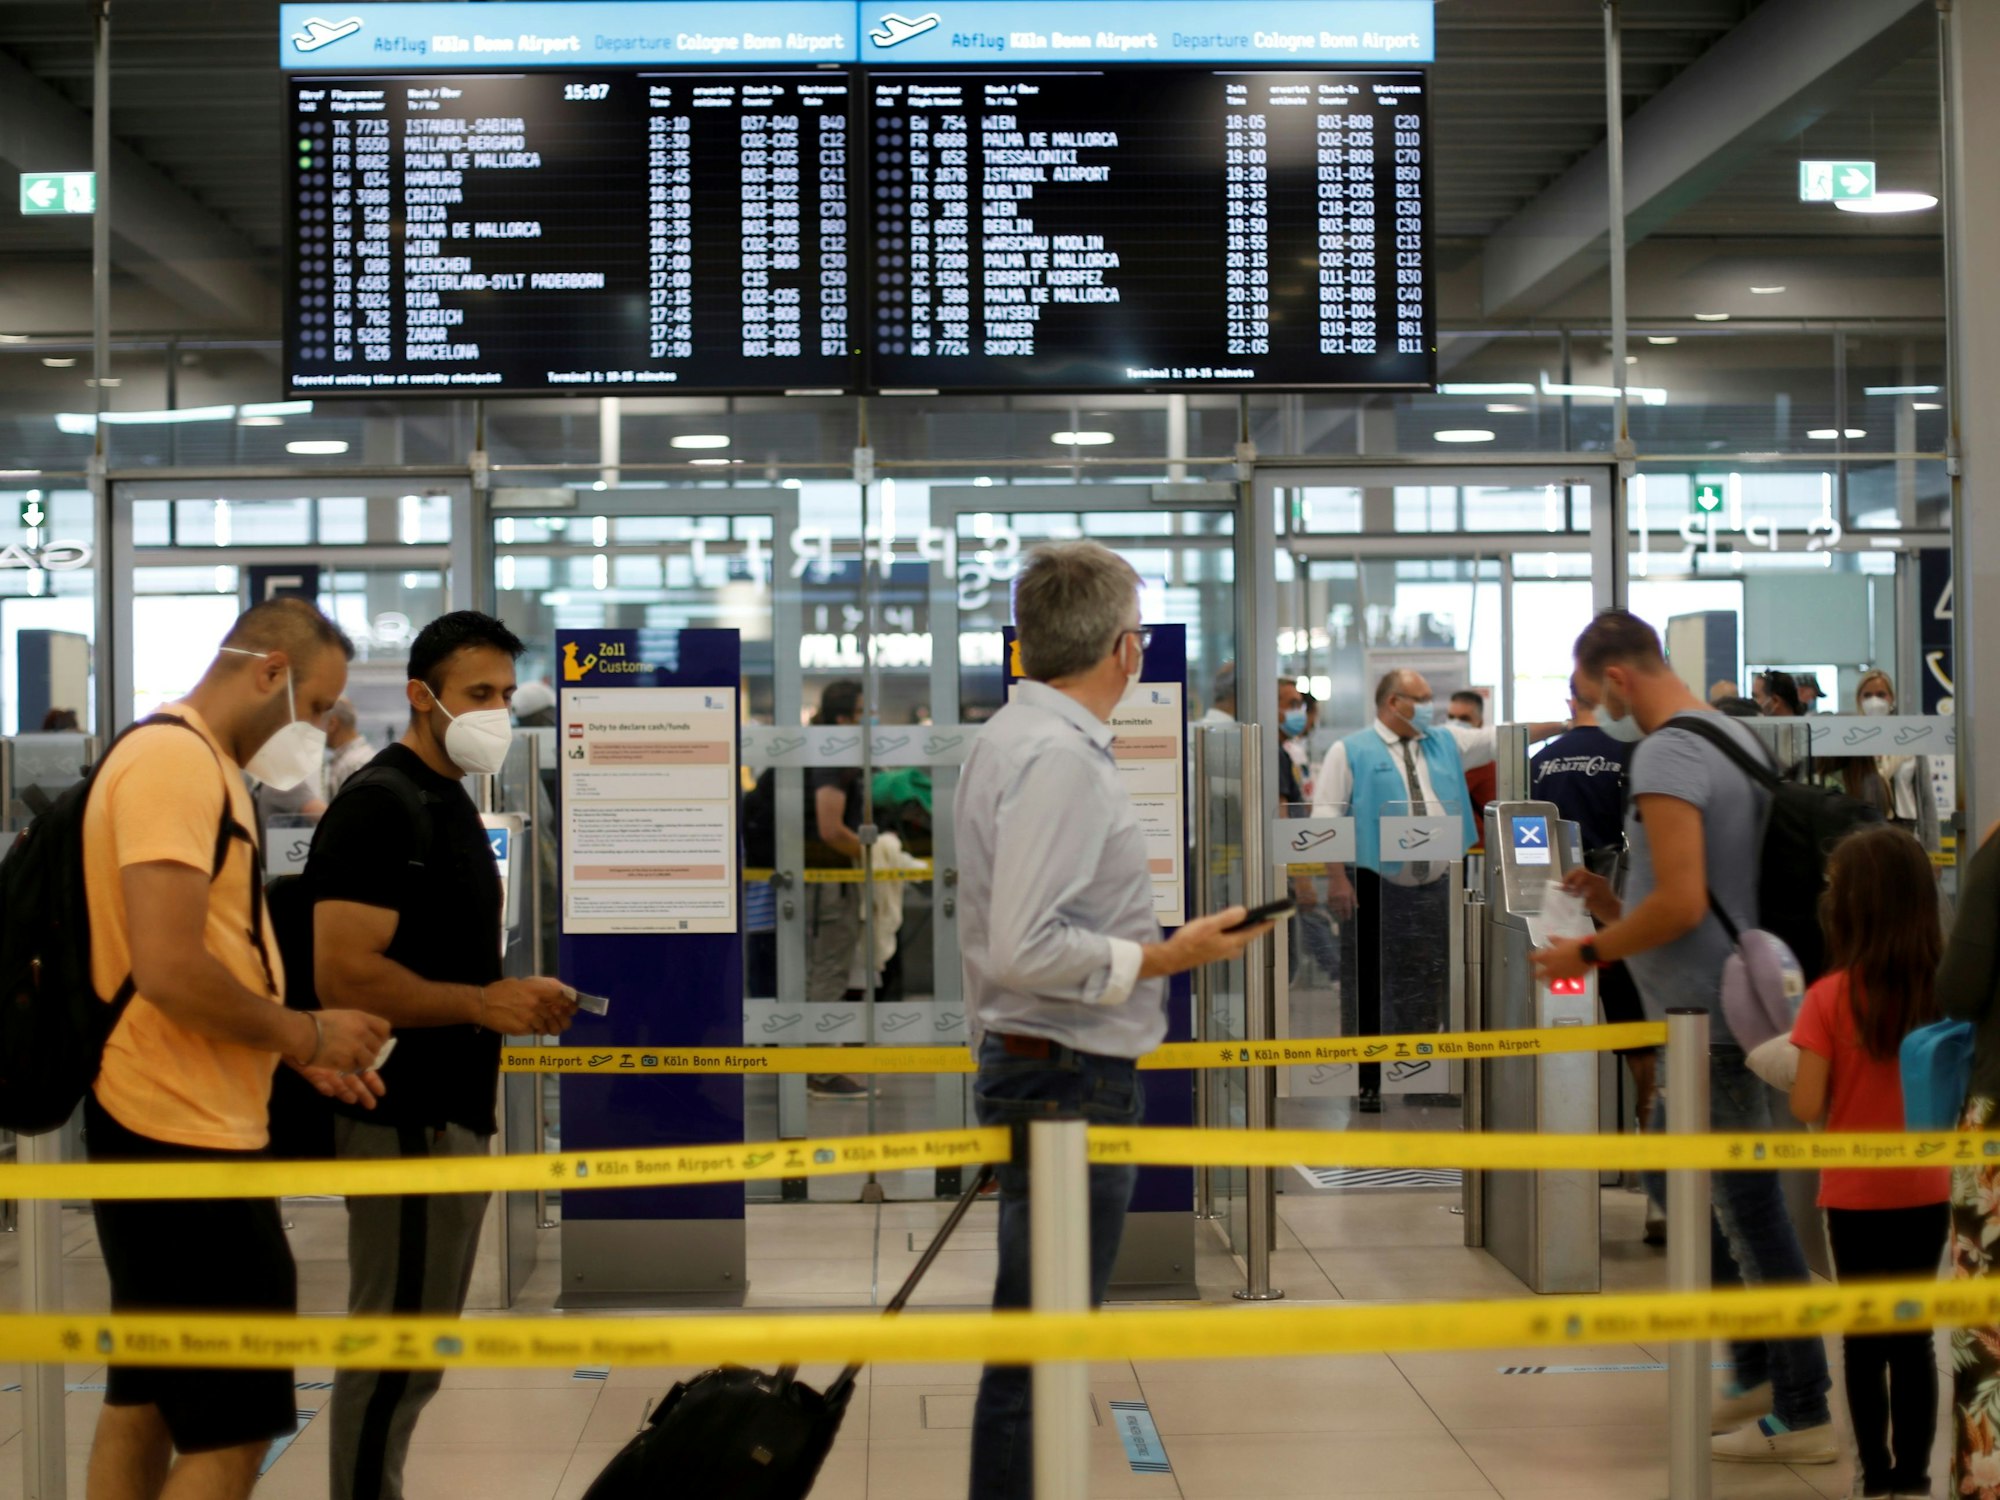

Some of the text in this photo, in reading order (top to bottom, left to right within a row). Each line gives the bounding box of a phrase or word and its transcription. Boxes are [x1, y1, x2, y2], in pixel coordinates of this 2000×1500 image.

[374, 37, 426, 53] Abflug
[473, 35, 513, 52] Bonn
[518, 35, 581, 54] Airport
[595, 35, 671, 50] Departure
[676, 33, 738, 50] Cologne
[743, 34, 782, 50] Bonn
[786, 33, 844, 50] Airport
[952, 33, 1004, 50] Abflug
[1052, 33, 1092, 48] Bonn
[1095, 32, 1157, 49] Airport
[1172, 33, 1249, 49] Departure
[1253, 32, 1315, 48] Cologne
[1320, 32, 1359, 48] Bonn
[1363, 32, 1419, 49] Airport
[564, 83, 609, 100] 15:07
[649, 116, 690, 134] 15:10
[942, 114, 1419, 130] 754 WIEN 18:05 B03-B08 C20
[649, 133, 690, 149] 15:30
[910, 132, 1420, 147] FR PALMA DE MALLORCA 18:30 C02-C05 D10
[649, 151, 690, 166] 15:35
[941, 149, 1420, 165] 652 THESSALONIKI 19:00 B03-B08 C70
[405, 171, 462, 186] HAMBURG
[911, 166, 1420, 182] TK 1676 ISTANBUL AIRPORT 19:20 D31-D34 B50
[405, 188, 462, 204] CRAIOVA
[911, 183, 1420, 200] FR 8036 DUBLIN 19:35 C02-C05 B21
[407, 203, 690, 221] IBIZA 16:30
[910, 200, 1421, 217] OS WIEN 19:45 C18-C20 C50
[934, 218, 1421, 234] 8055 BERLIN 19:50 B03-B08 C30
[911, 235, 1421, 251] FR 1404 WARSCHAU MODLIN 19:55 C02-C05 C13
[911, 252, 1421, 269] FR 7208 PALMA DE MALLORCA 20:15 C02-C05 C12
[911, 271, 929, 286] XC
[936, 271, 968, 286] 1504
[1227, 270, 1268, 284] 20:20
[1320, 269, 1375, 284] D11-D12
[1397, 269, 1422, 284] B30
[406, 290, 440, 308] RIGA
[984, 288, 1026, 303] PALMA
[1031, 288, 1049, 303] DE
[1054, 287, 1120, 303] MALLORCA
[1227, 287, 1268, 302] 20:30
[1320, 287, 1376, 301] B03-B08
[1397, 287, 1422, 301] C40
[406, 307, 463, 325] ZUERICH
[912, 304, 1422, 321] PC 1608 KAYSERI 21:10 D01-D04 B40
[985, 321, 1422, 338] TANGER 21:30 B19-B22 B61
[406, 341, 691, 360] BARCELONA 17:50
[936, 338, 1422, 355] 7724 SKOPJE 22:05 D21-D22 B11
[1126, 368, 1169, 378] Terminal
[1214, 368, 1254, 378] minutes
[600, 642, 625, 656] Zoll
[589, 723, 607, 732] Duty
[648, 723, 690, 732] cash/funds
[1112, 718, 1153, 726] Barmitteln
[1254, 1038, 1541, 1062] Köln Bonn Airport Köln Bonn Airport
[508, 1054, 768, 1070] Bonn Airport Köln Bonn Airport
[596, 1139, 980, 1175] Köln Bonn Airport Köln Bonn Airport
[1773, 1142, 1906, 1160] Köln Bonn Airport
